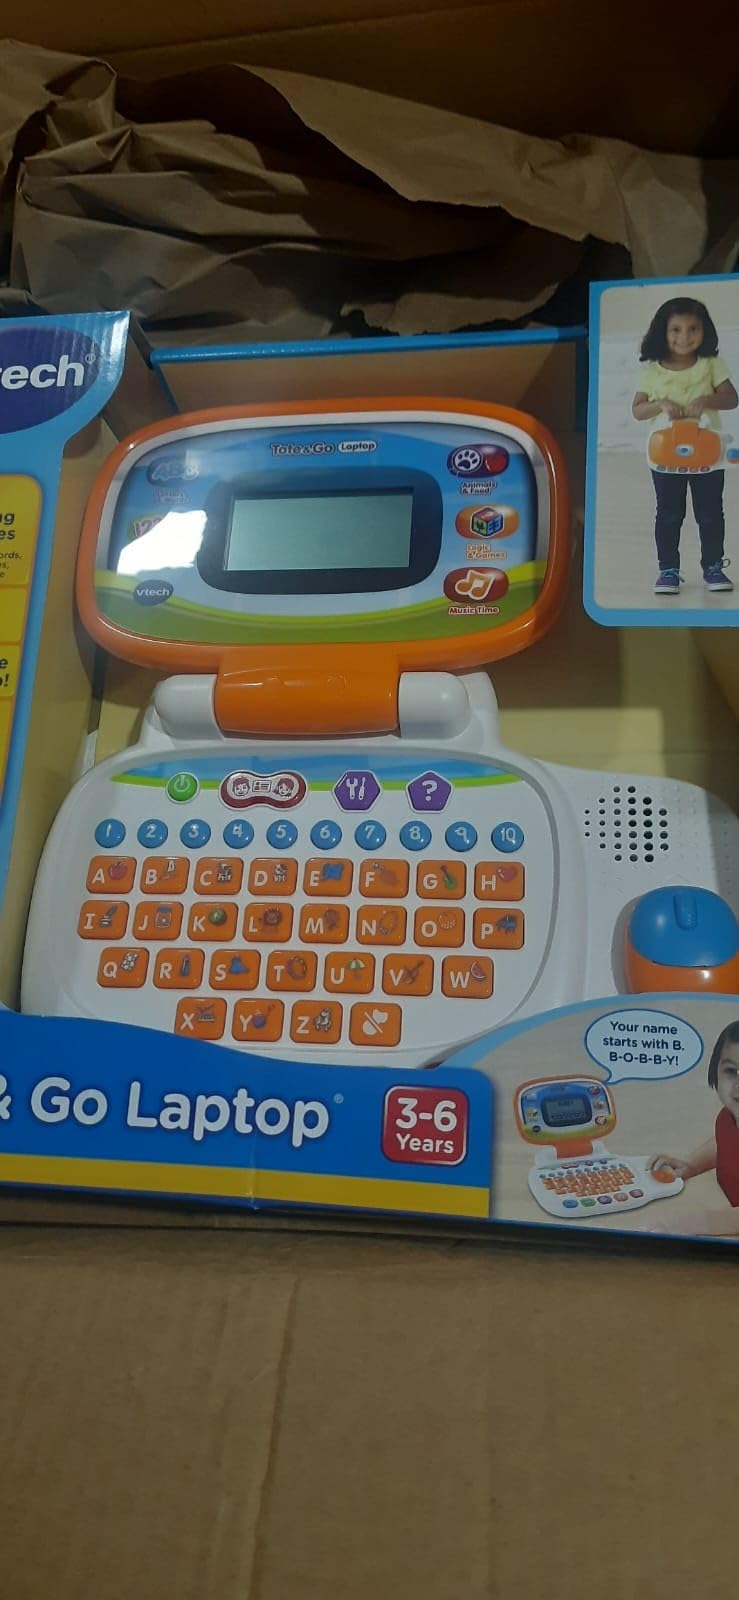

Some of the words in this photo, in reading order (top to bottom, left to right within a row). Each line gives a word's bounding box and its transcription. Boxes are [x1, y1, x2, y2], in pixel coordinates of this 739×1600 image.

[0, 354, 85, 390] ech
[341, 442, 375, 452] Laptop
[462, 481, 497, 489] Animals
[136, 585, 170, 597] vtech
[449, 606, 475, 615] Music
[477, 606, 499, 614] Time
[104, 823, 113, 838] 1
[145, 823, 156, 838] 2
[188, 824, 200, 839] 3
[232, 823, 243, 838] 4
[275, 824, 287, 839] 5
[319, 824, 331, 839] 6
[364, 825, 376, 839] 7
[409, 825, 421, 840] 8
[454, 826, 467, 842] 9
[500, 827, 516, 843] 10
[92, 868, 105, 884] A
[145, 869, 158, 885] B
[199, 870, 212, 886] C
[254, 870, 268, 886] D
[309, 870, 320, 886] E
[365, 871, 375, 887] F
[423, 874, 438, 890] G
[481, 875, 496, 891] H
[84, 913, 95, 929] I
[138, 915, 148, 931] J
[192, 916, 205, 932] K
[249, 917, 258, 932] L
[305, 918, 324, 934] M
[361, 920, 376, 936] N
[421, 921, 437, 937] O
[481, 923, 494, 940] P
[103, 961, 117, 978] Q
[159, 963, 172, 979] R
[215, 964, 226, 980] S
[273, 965, 285, 982] T
[330, 967, 344, 984] U
[389, 969, 404, 986] V
[450, 971, 470, 988] W
[180, 1013, 195, 1030] X
[239, 1015, 253, 1032] Y
[296, 1016, 310, 1034] Z
[610, 1021, 640, 1033] Your
[643, 1024, 678, 1035] name
[603, 1037, 638, 1049] starts
[641, 1038, 669, 1050] with
[673, 1040, 685, 1051] B.
[609, 1051, 679, 1066] B-O-B-B-Y!
[31, 1076, 108, 1125] Go
[127, 1081, 329, 1148] Laptop
[395, 1097, 458, 1132] 3-6
[395, 1133, 454, 1154] Years
